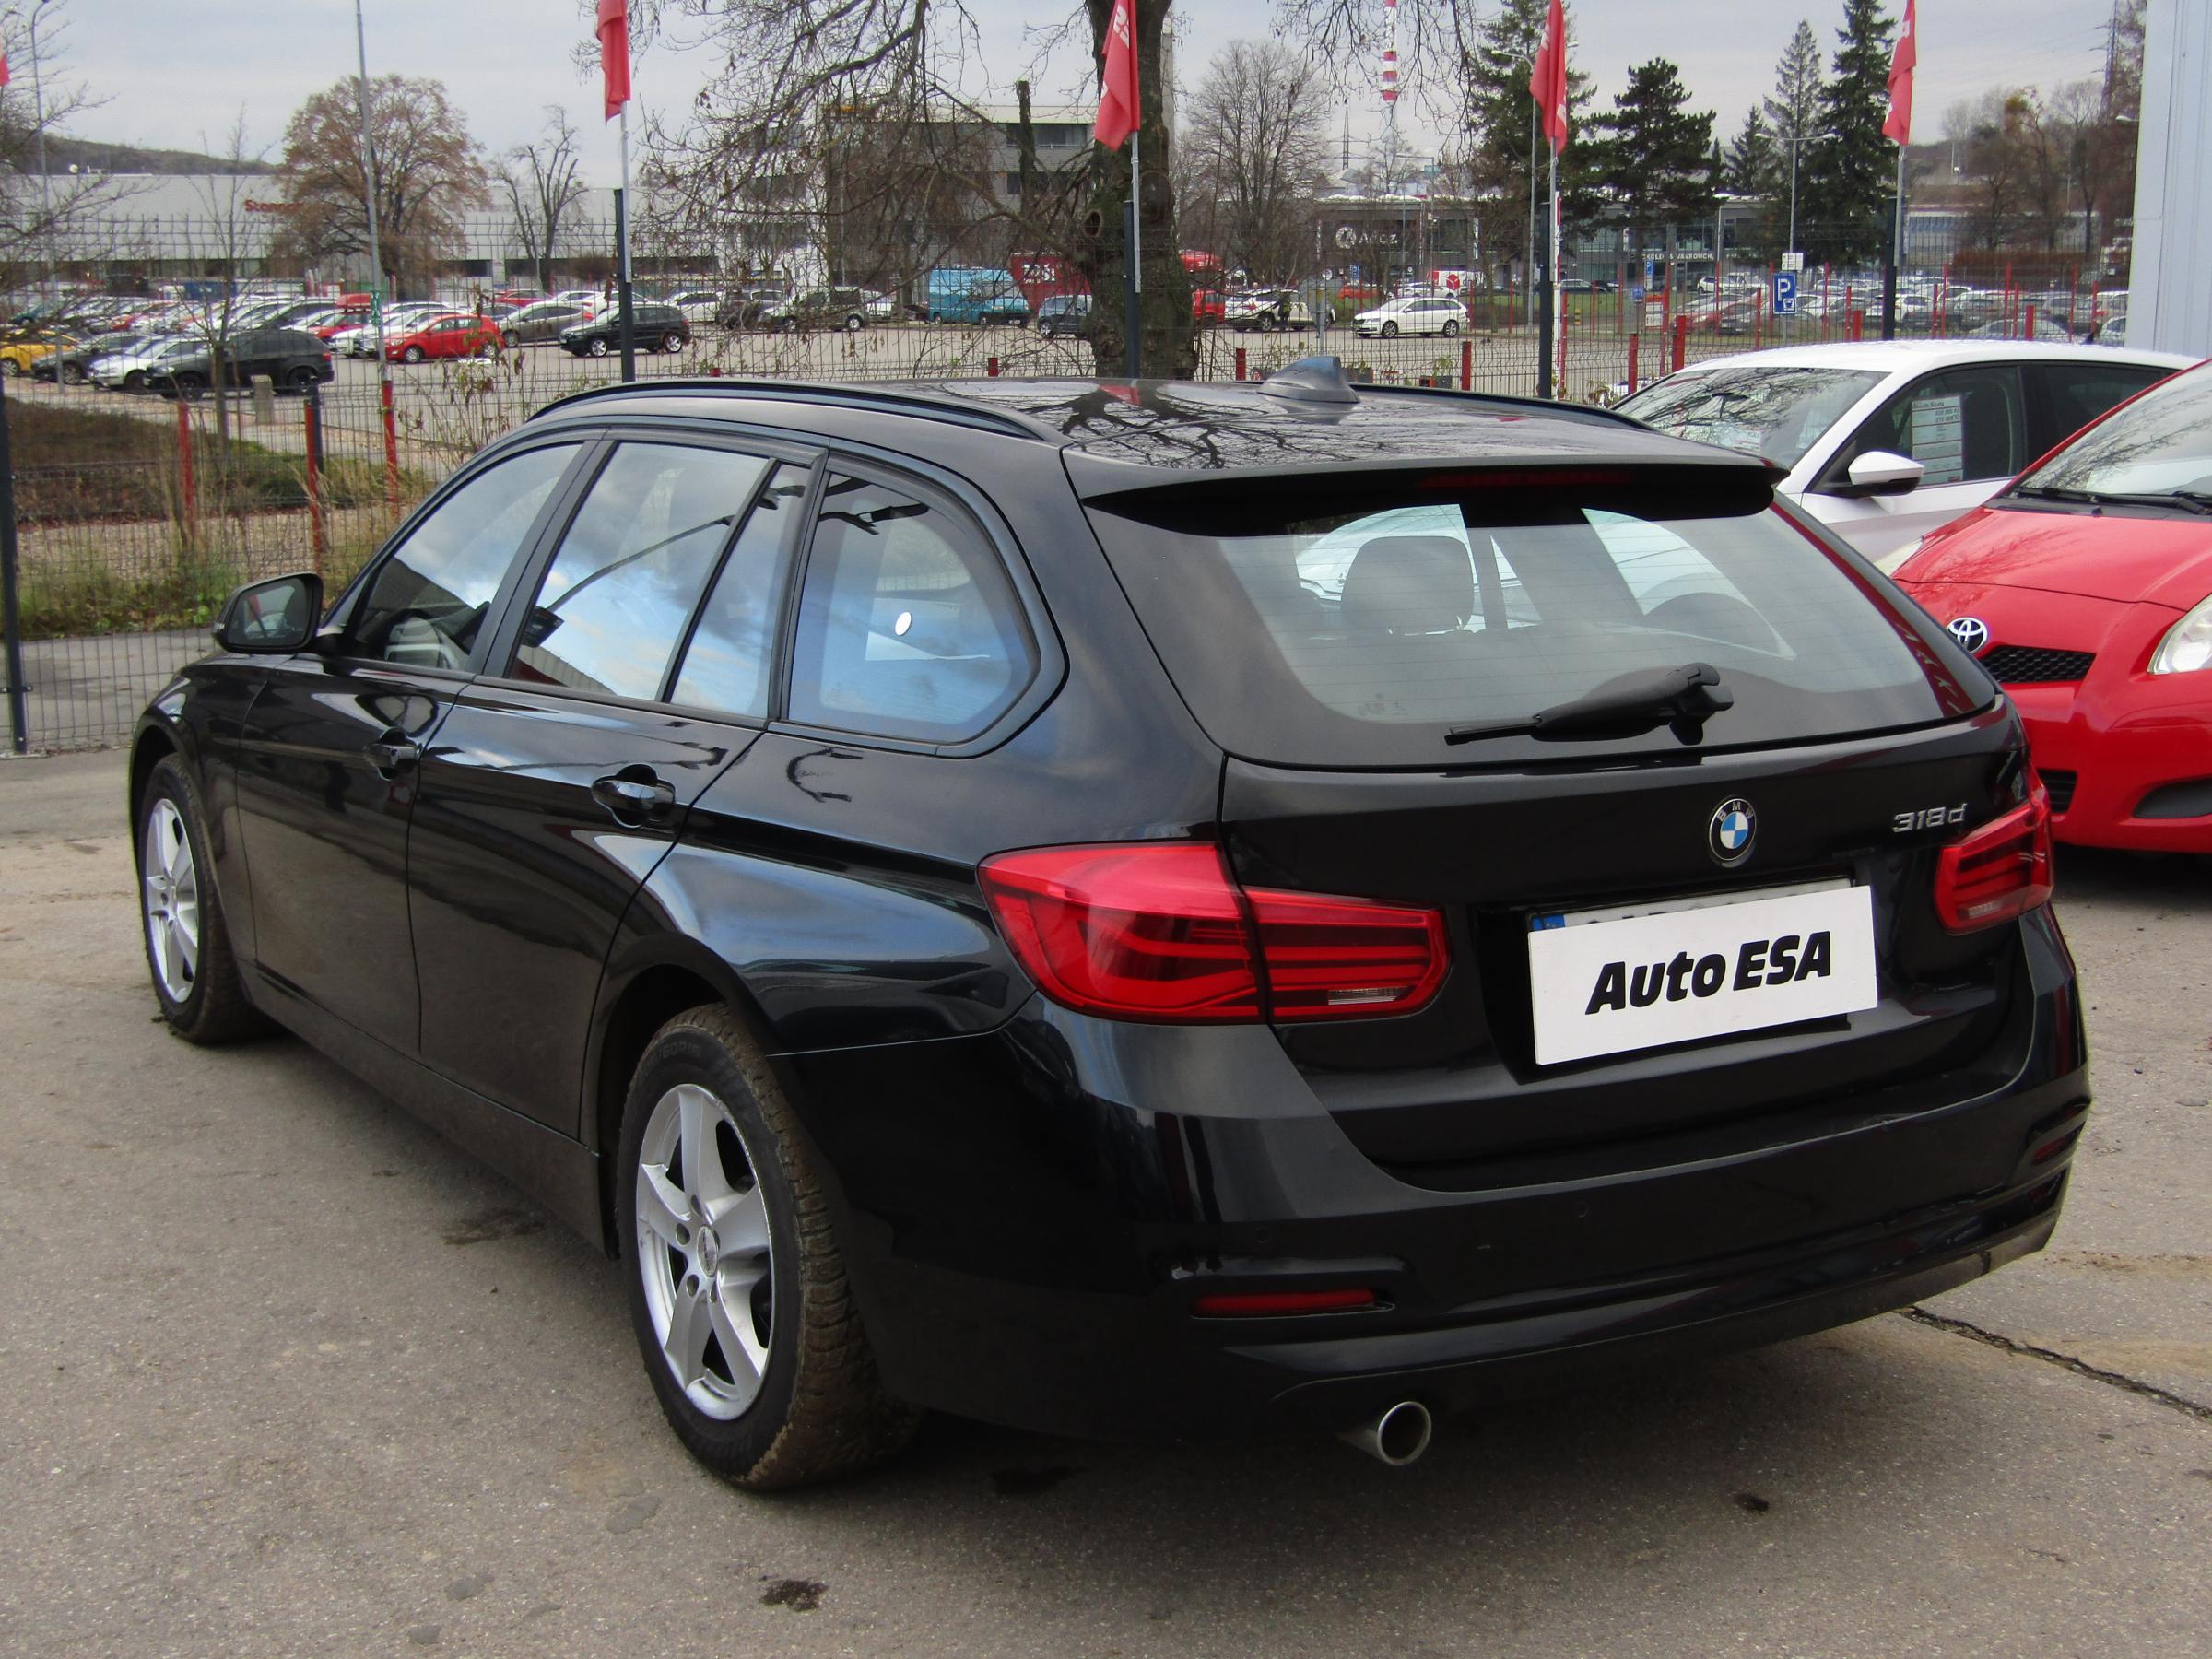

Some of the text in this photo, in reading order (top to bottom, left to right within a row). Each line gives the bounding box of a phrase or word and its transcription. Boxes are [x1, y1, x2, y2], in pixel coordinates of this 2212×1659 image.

[1777, 278, 1791, 301] P
[1716, 800, 1754, 822] BMW
[1892, 803, 1968, 833] 318d
[1584, 930, 1831, 1015] Auto ESA
